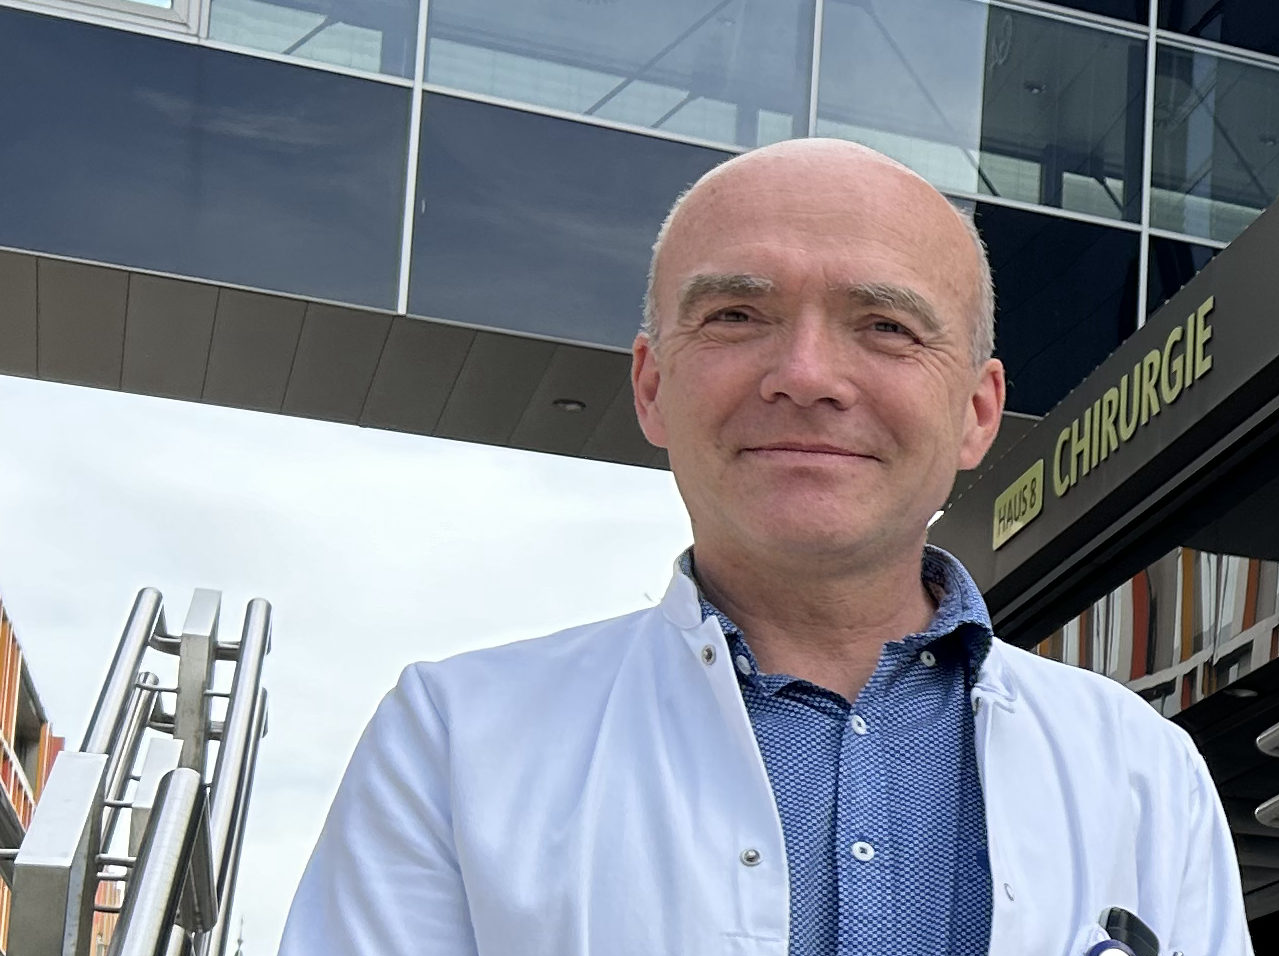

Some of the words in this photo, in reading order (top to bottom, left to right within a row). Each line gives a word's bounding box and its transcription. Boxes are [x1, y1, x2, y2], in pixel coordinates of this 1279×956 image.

[1053, 295, 1215, 498] CHIRURGIE
[997, 488, 1029, 536] HAUS
[1029, 477, 1037, 508] 8
